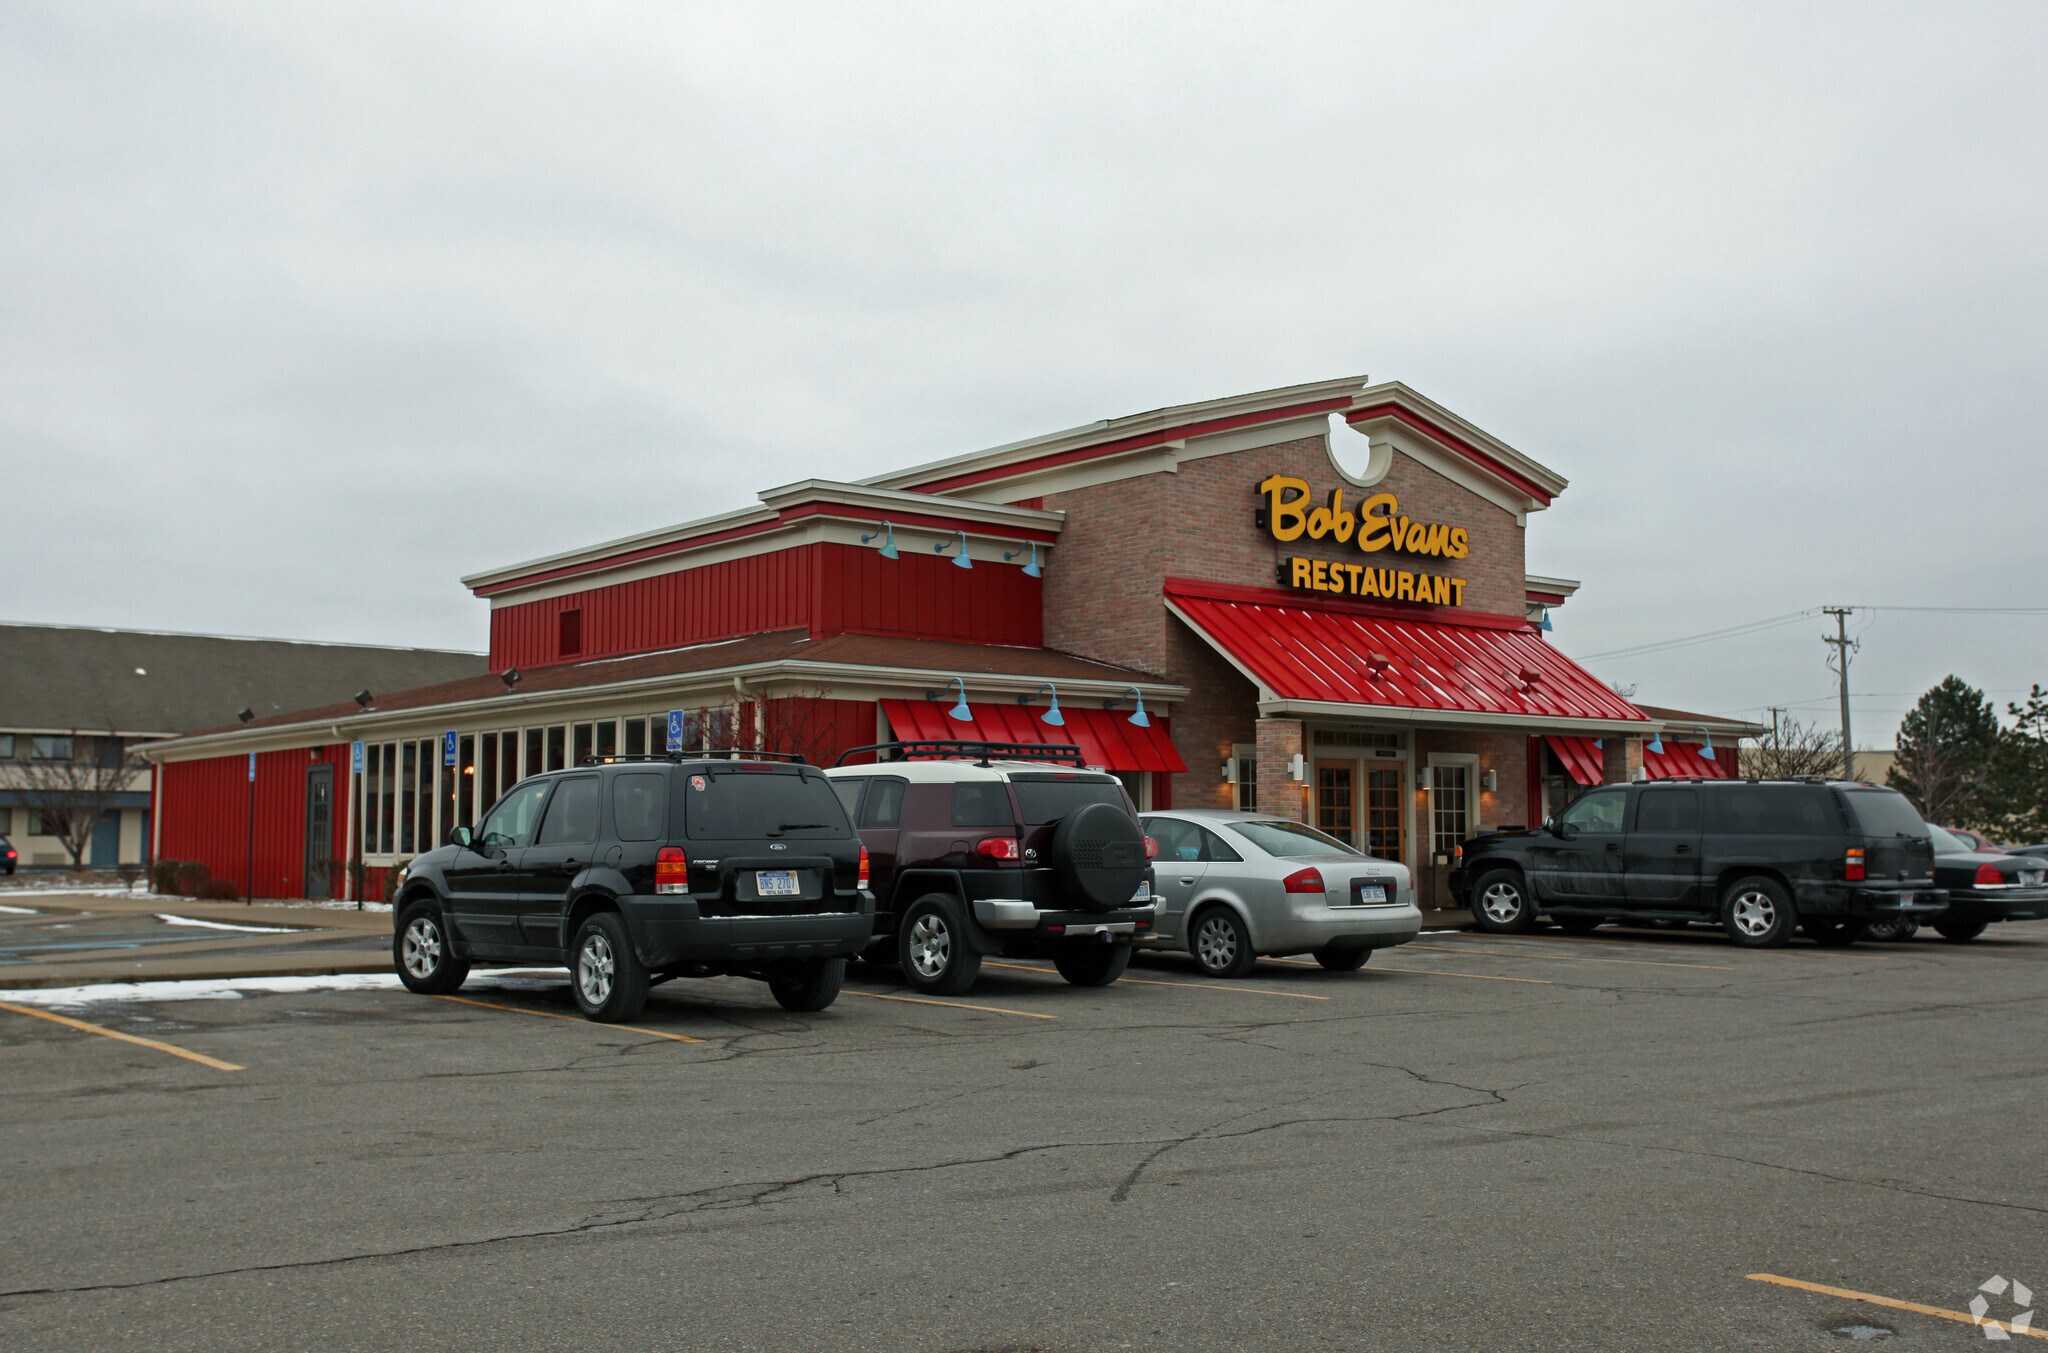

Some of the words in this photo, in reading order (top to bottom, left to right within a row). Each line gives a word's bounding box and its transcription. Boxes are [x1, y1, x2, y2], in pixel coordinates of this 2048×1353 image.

[1260, 473, 1355, 543] Bob
[1357, 492, 1469, 560] Evans
[1290, 556, 1468, 607] RESTAURANT
[760, 878, 774, 890] BNS
[777, 877, 795, 889] 2707
